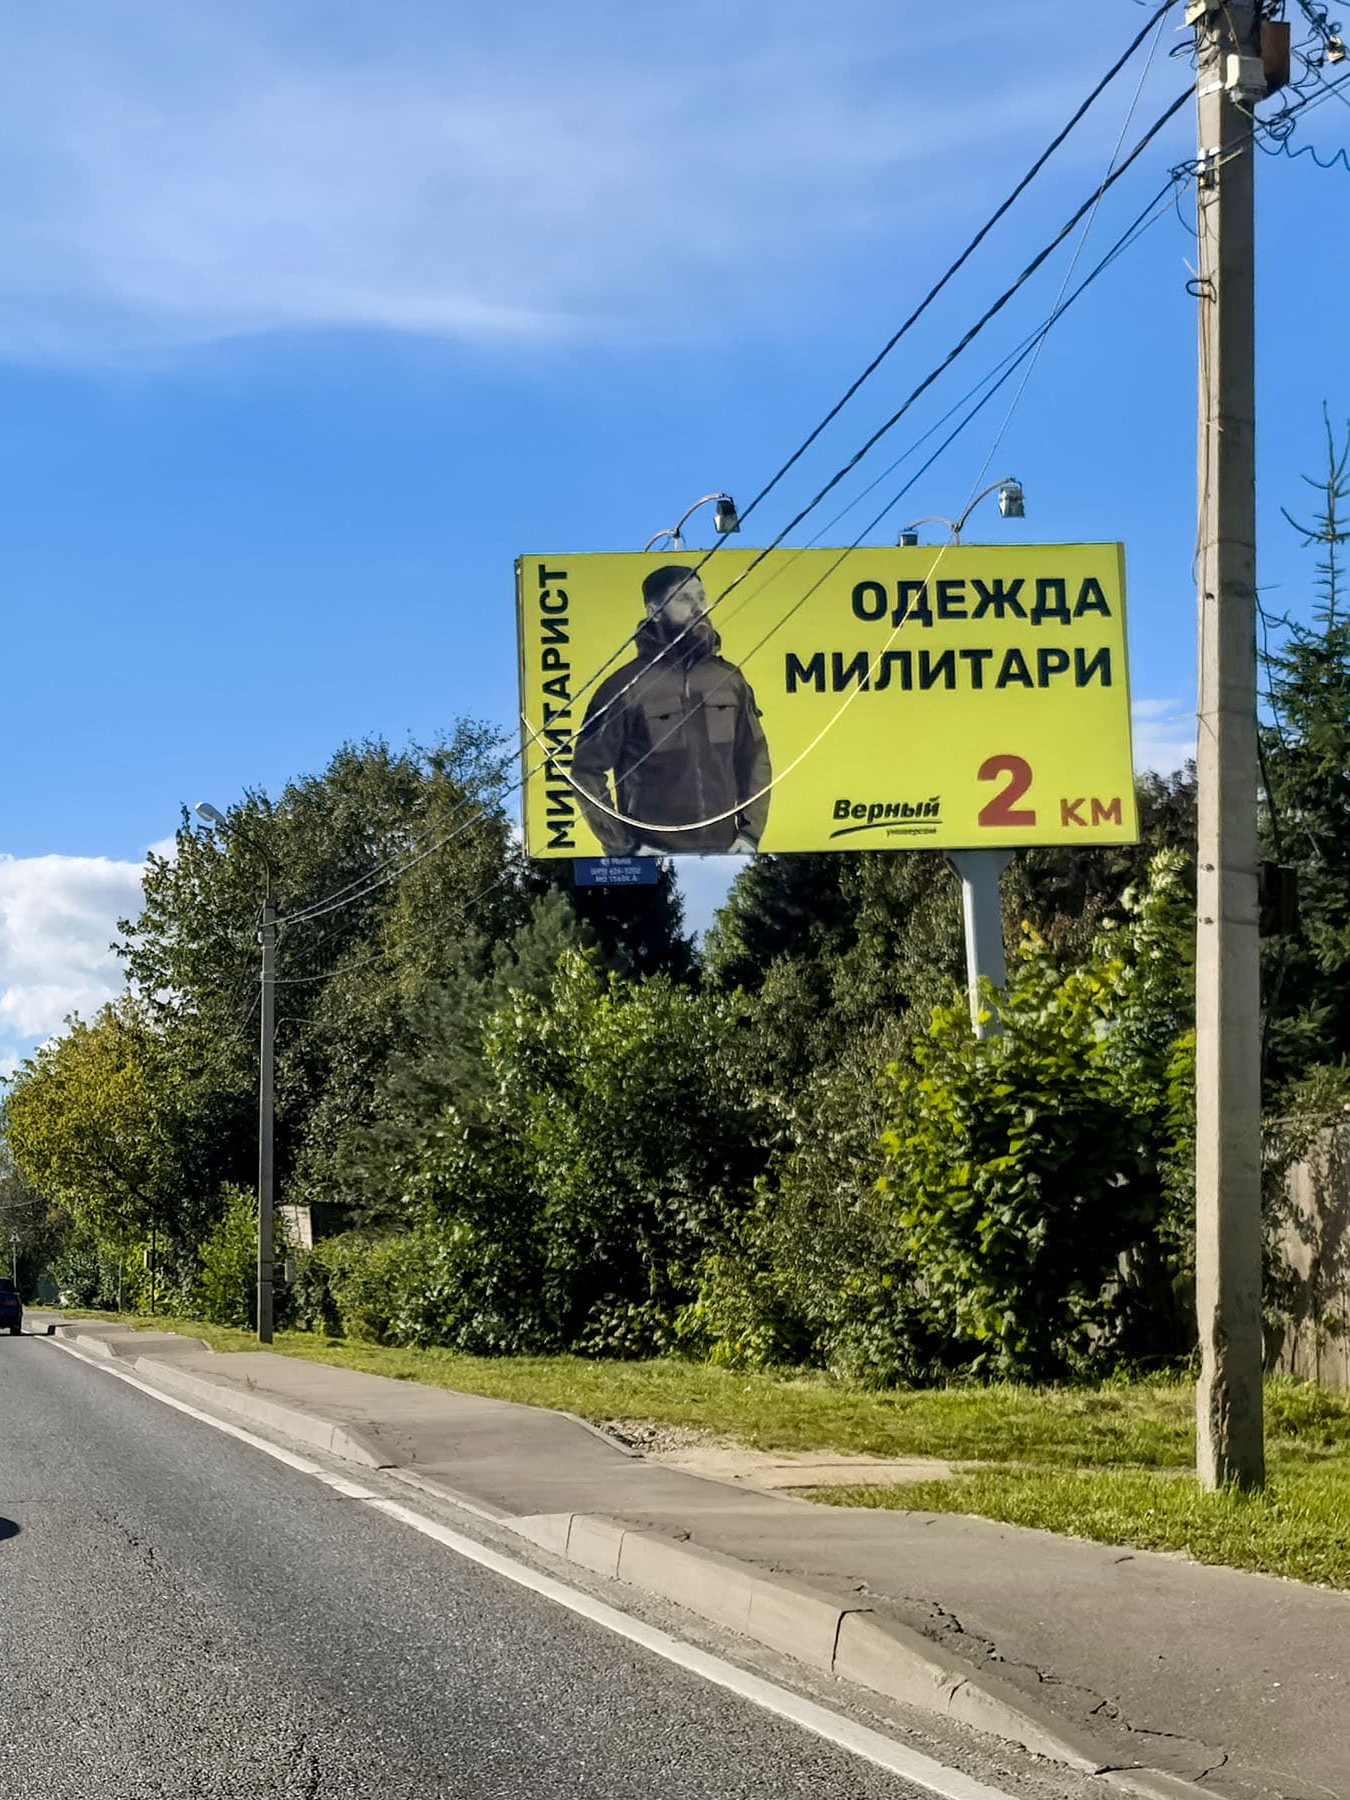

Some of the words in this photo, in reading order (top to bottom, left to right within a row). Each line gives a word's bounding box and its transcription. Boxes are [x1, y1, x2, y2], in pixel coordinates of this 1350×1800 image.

[851, 577, 1112, 628] ОДЕЖДА
[785, 647, 1112, 693] МИЛИТАРИ
[538, 564, 575, 849] МИЛИТАРИСТ
[833, 795, 941, 824] Верный
[977, 754, 1036, 827] 2
